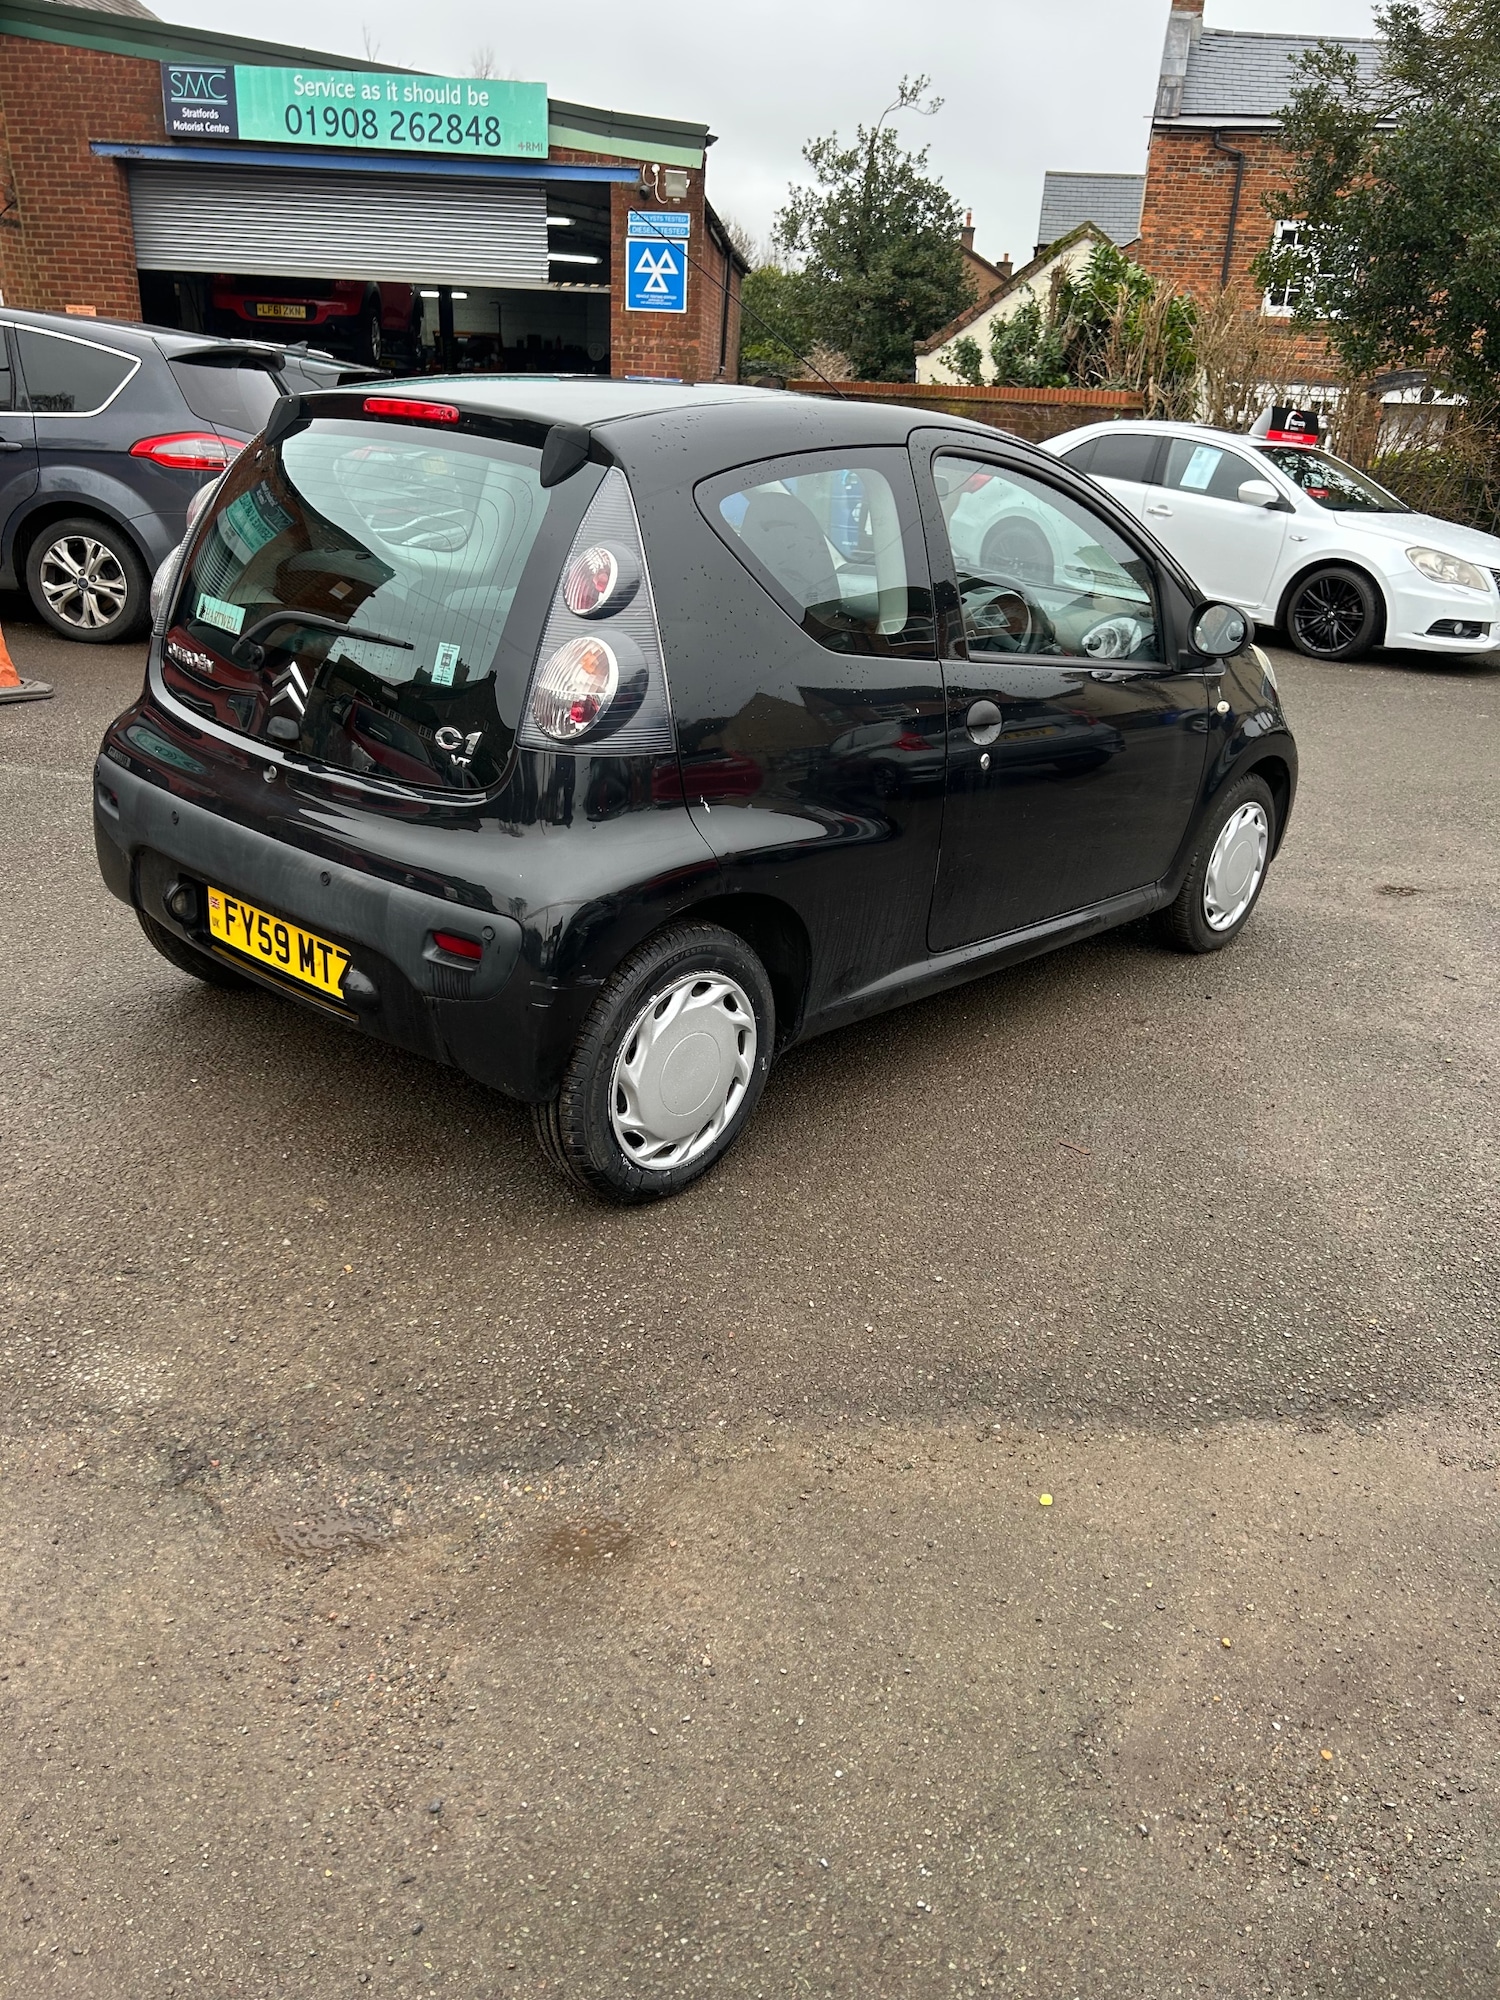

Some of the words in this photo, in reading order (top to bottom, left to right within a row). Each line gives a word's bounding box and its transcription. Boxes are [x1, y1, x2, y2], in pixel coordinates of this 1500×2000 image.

[170, 72, 227, 99] SMC
[293, 75, 356, 98] Service
[361, 83, 381, 101] as
[386, 80, 399, 102] it
[403, 82, 461, 106] should
[467, 85, 489, 107] be
[181, 107, 219, 119] Stratfords
[284, 104, 379, 140] 01908
[389, 110, 502, 147] 262848
[173, 120, 204, 132] Motorist
[205, 121, 230, 134] Centre
[525, 141, 543, 152] RMI
[660, 227, 686, 235] TESTED
[664, 215, 687, 223] TESTED
[204, 607, 238, 632] HARTWELL
[434, 726, 483, 756] C1
[224, 897, 291, 965] FY59
